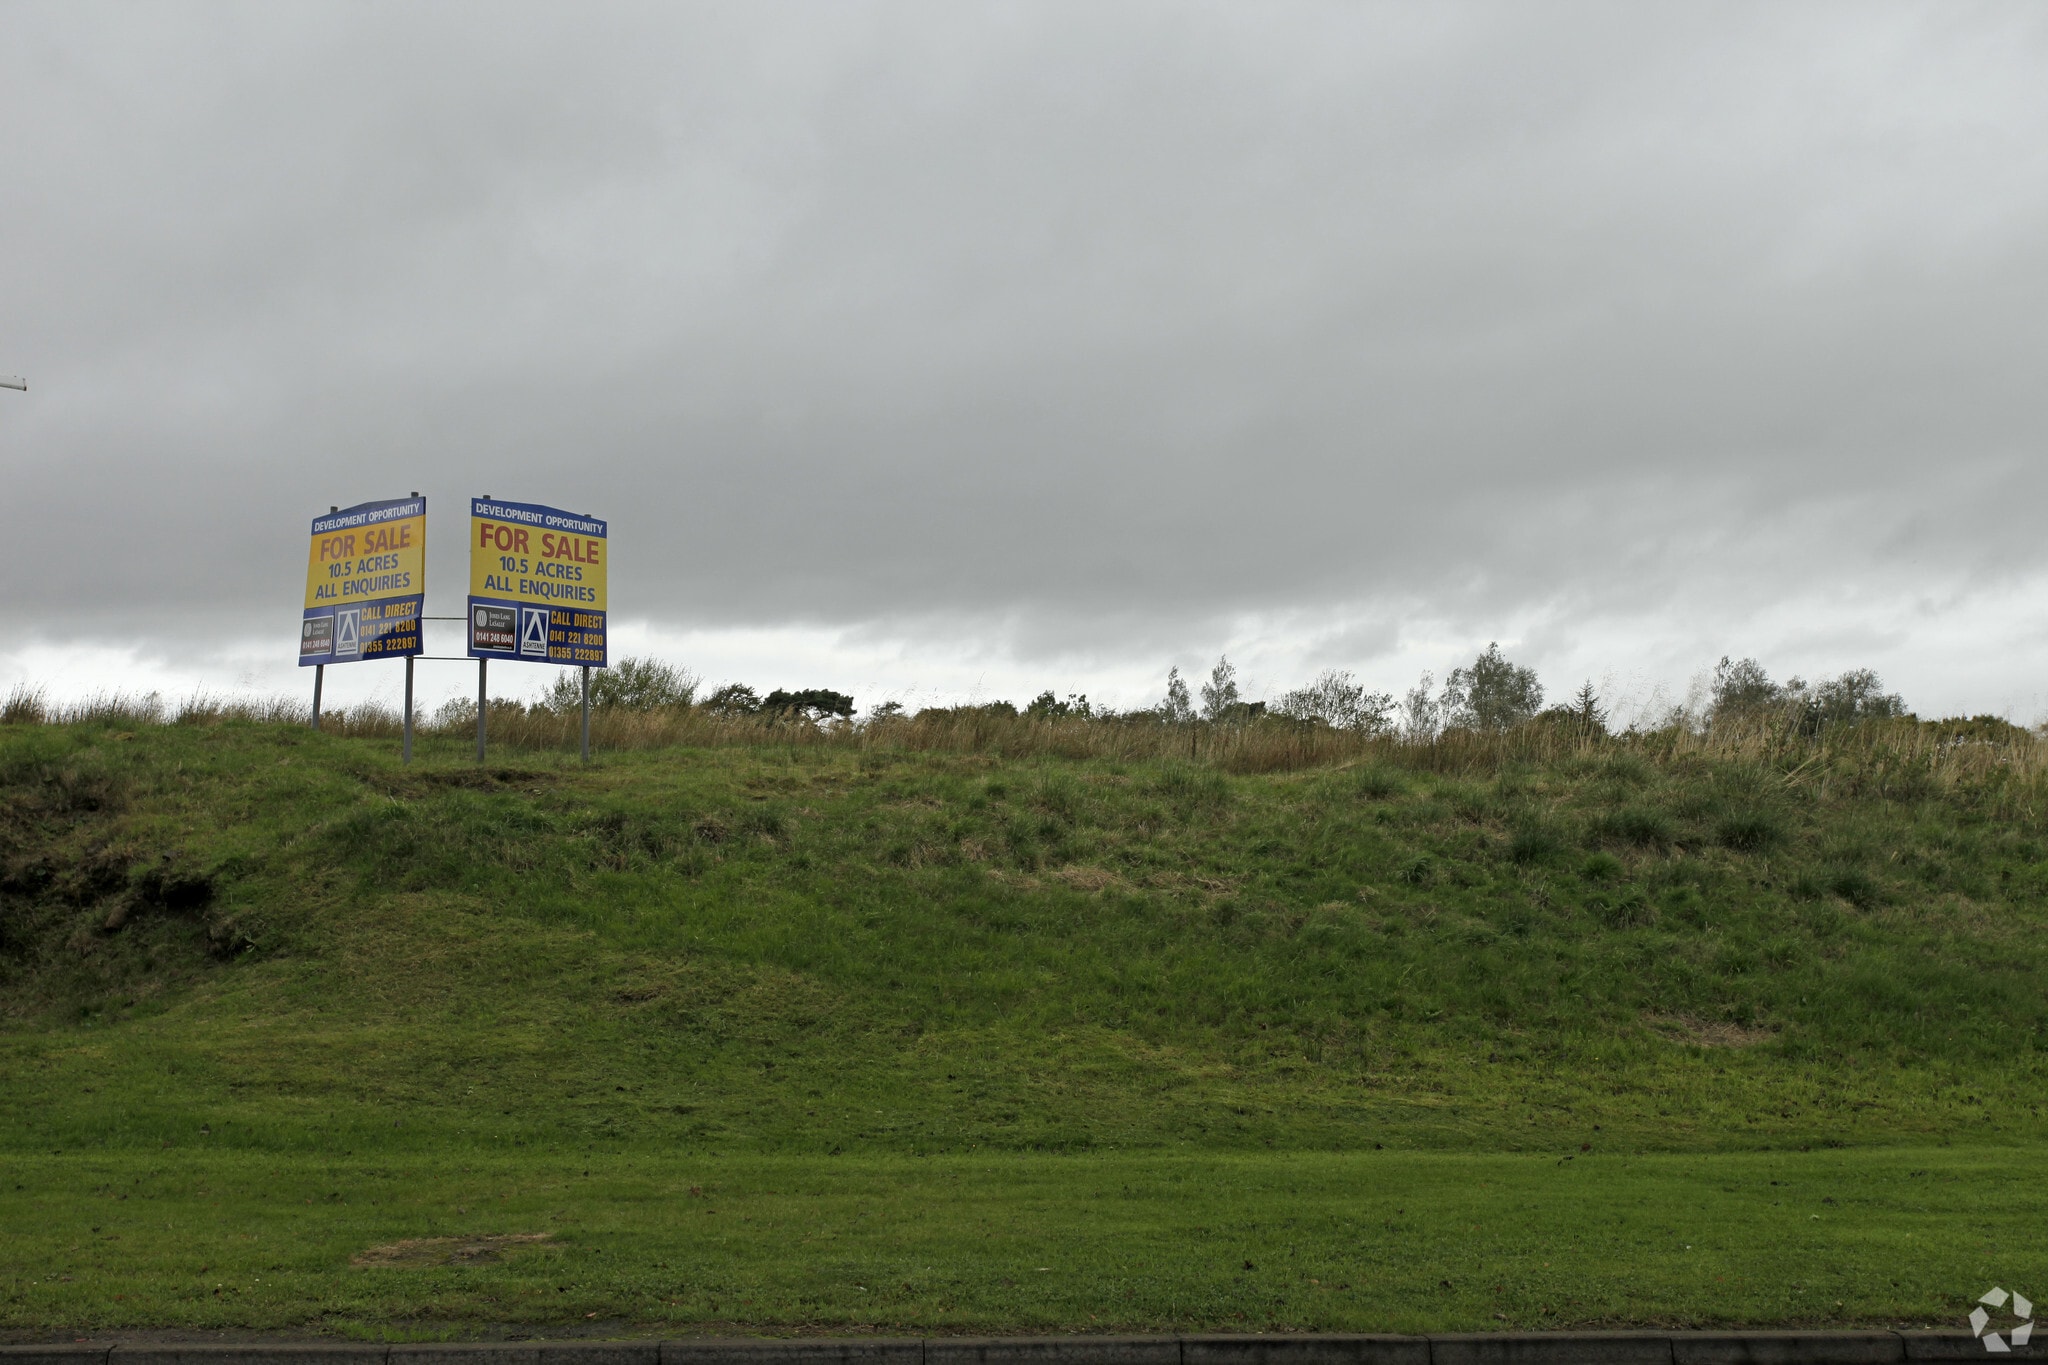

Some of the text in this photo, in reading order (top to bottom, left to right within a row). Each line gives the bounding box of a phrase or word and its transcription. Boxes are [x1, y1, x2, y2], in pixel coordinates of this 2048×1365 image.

[314, 503, 420, 532] DEVELOPMENT OPPORTUNITY
[476, 503, 603, 534] DEVELOPMENT OPPORTUNITY
[320, 525, 411, 562] FOR SALE
[481, 523, 599, 565] FOR SALE
[329, 554, 398, 578] 10.5 ACRES
[499, 556, 582, 581] 10.5 ACRES
[315, 572, 410, 599] ALL ENQUIRIES
[484, 574, 595, 602] ALL ENQUIRIES
[361, 601, 417, 621] CALL DIRECT
[551, 611, 603, 629] CALL DIRECT
[361, 620, 416, 636] 0141 221 8200
[476, 632, 489, 641] 0141
[501, 635, 513, 643] 6040
[550, 630, 603, 646] 0141 221 8200
[360, 637, 416, 653] 01355 222897
[548, 647, 603, 661] 01355 222897
